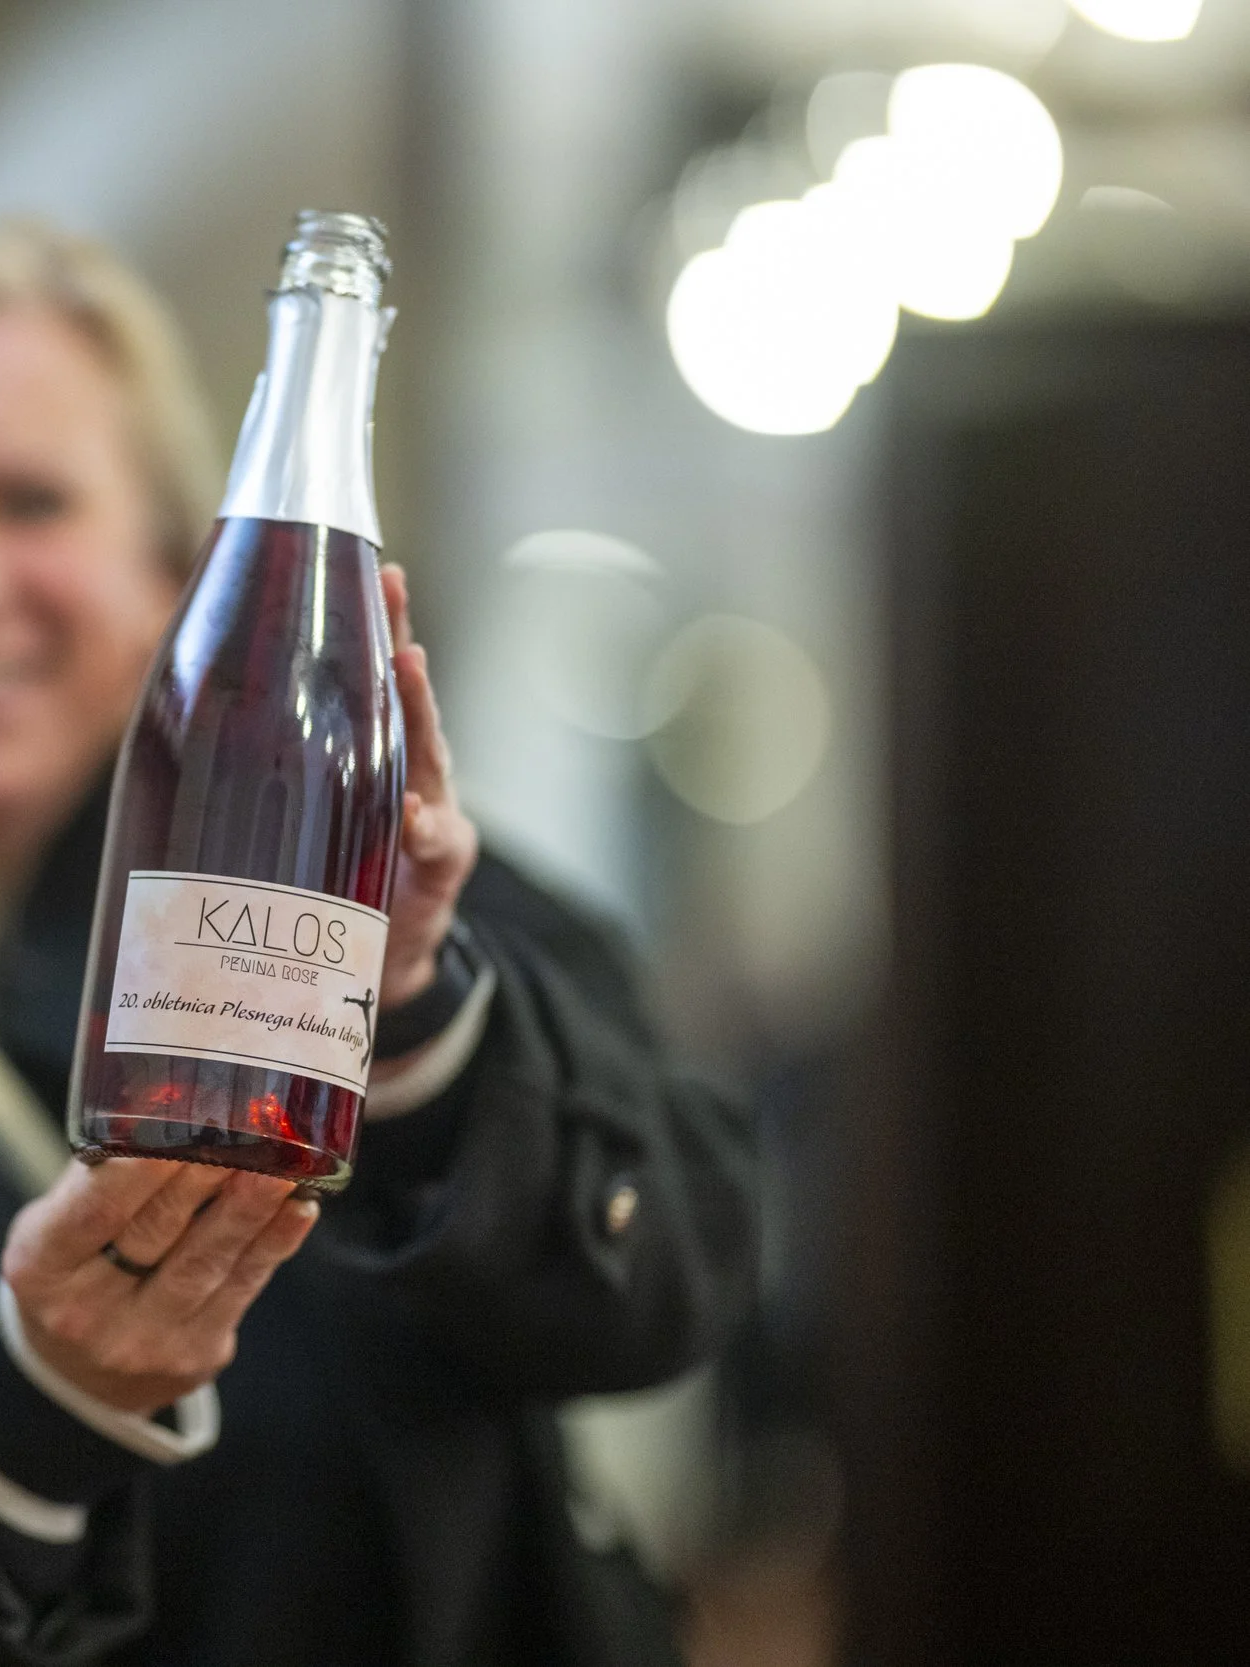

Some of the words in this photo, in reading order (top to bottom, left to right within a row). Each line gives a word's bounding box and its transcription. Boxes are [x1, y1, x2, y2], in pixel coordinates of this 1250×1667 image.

[197, 896, 347, 964] KALOS
[220, 955, 276, 978] PENINA
[118, 992, 138, 1009] 20.
[142, 991, 216, 1014] obletnica
[219, 1000, 294, 1032] Plesnega
[296, 1012, 337, 1038] kluba
[338, 1025, 364, 1052] Idrija
